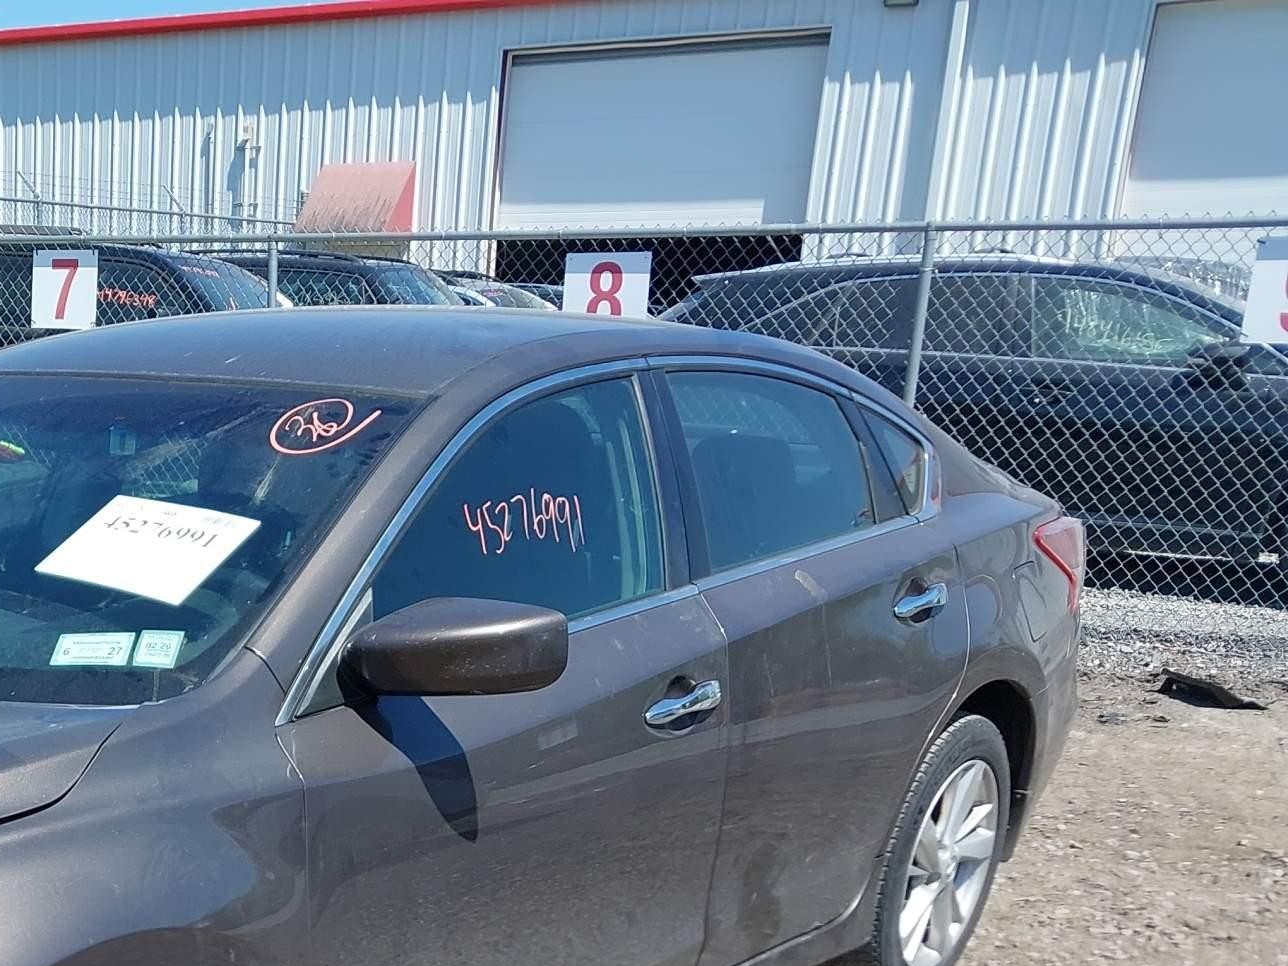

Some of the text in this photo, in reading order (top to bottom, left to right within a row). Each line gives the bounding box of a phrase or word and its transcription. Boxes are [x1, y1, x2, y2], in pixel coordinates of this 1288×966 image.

[51, 258, 79, 320] 7
[586, 260, 623, 317] 8
[103, 515, 219, 548] 45276991
[463, 487, 586, 555] 45276991
[107, 646, 123, 656] 27
